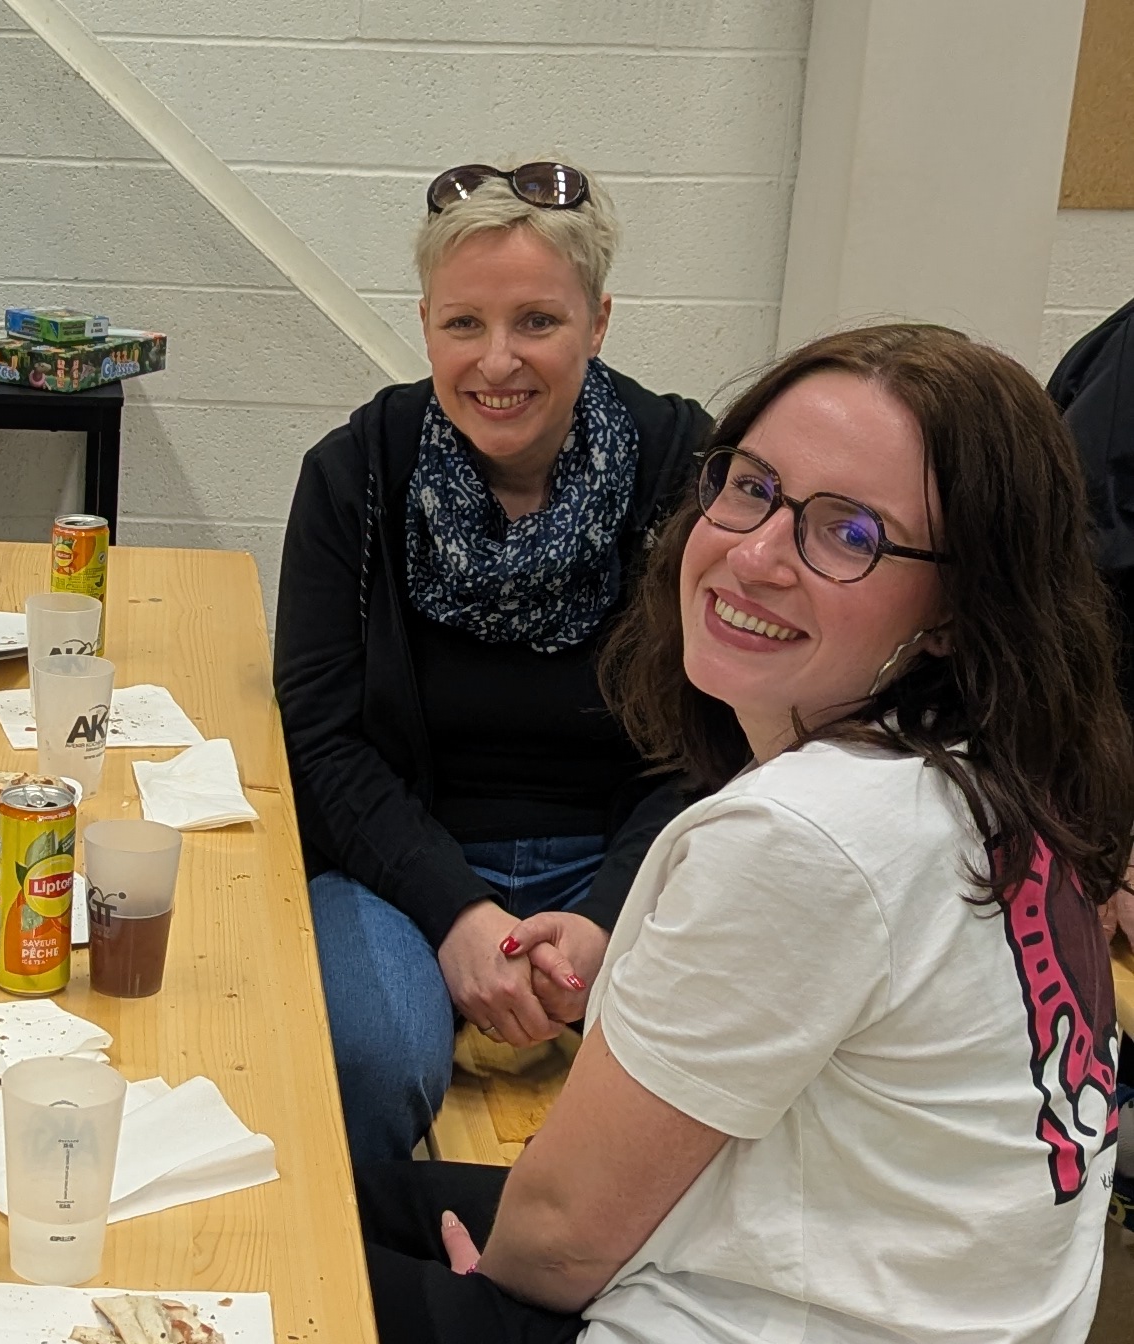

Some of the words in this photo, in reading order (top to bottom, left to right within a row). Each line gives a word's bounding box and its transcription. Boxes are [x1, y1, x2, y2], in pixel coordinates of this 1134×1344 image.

[66, 712, 107, 743] AK
[33, 876, 73, 895] Lipton
[22, 938, 57, 948] SAVEUR
[21, 946, 59, 959] PÊCHE
